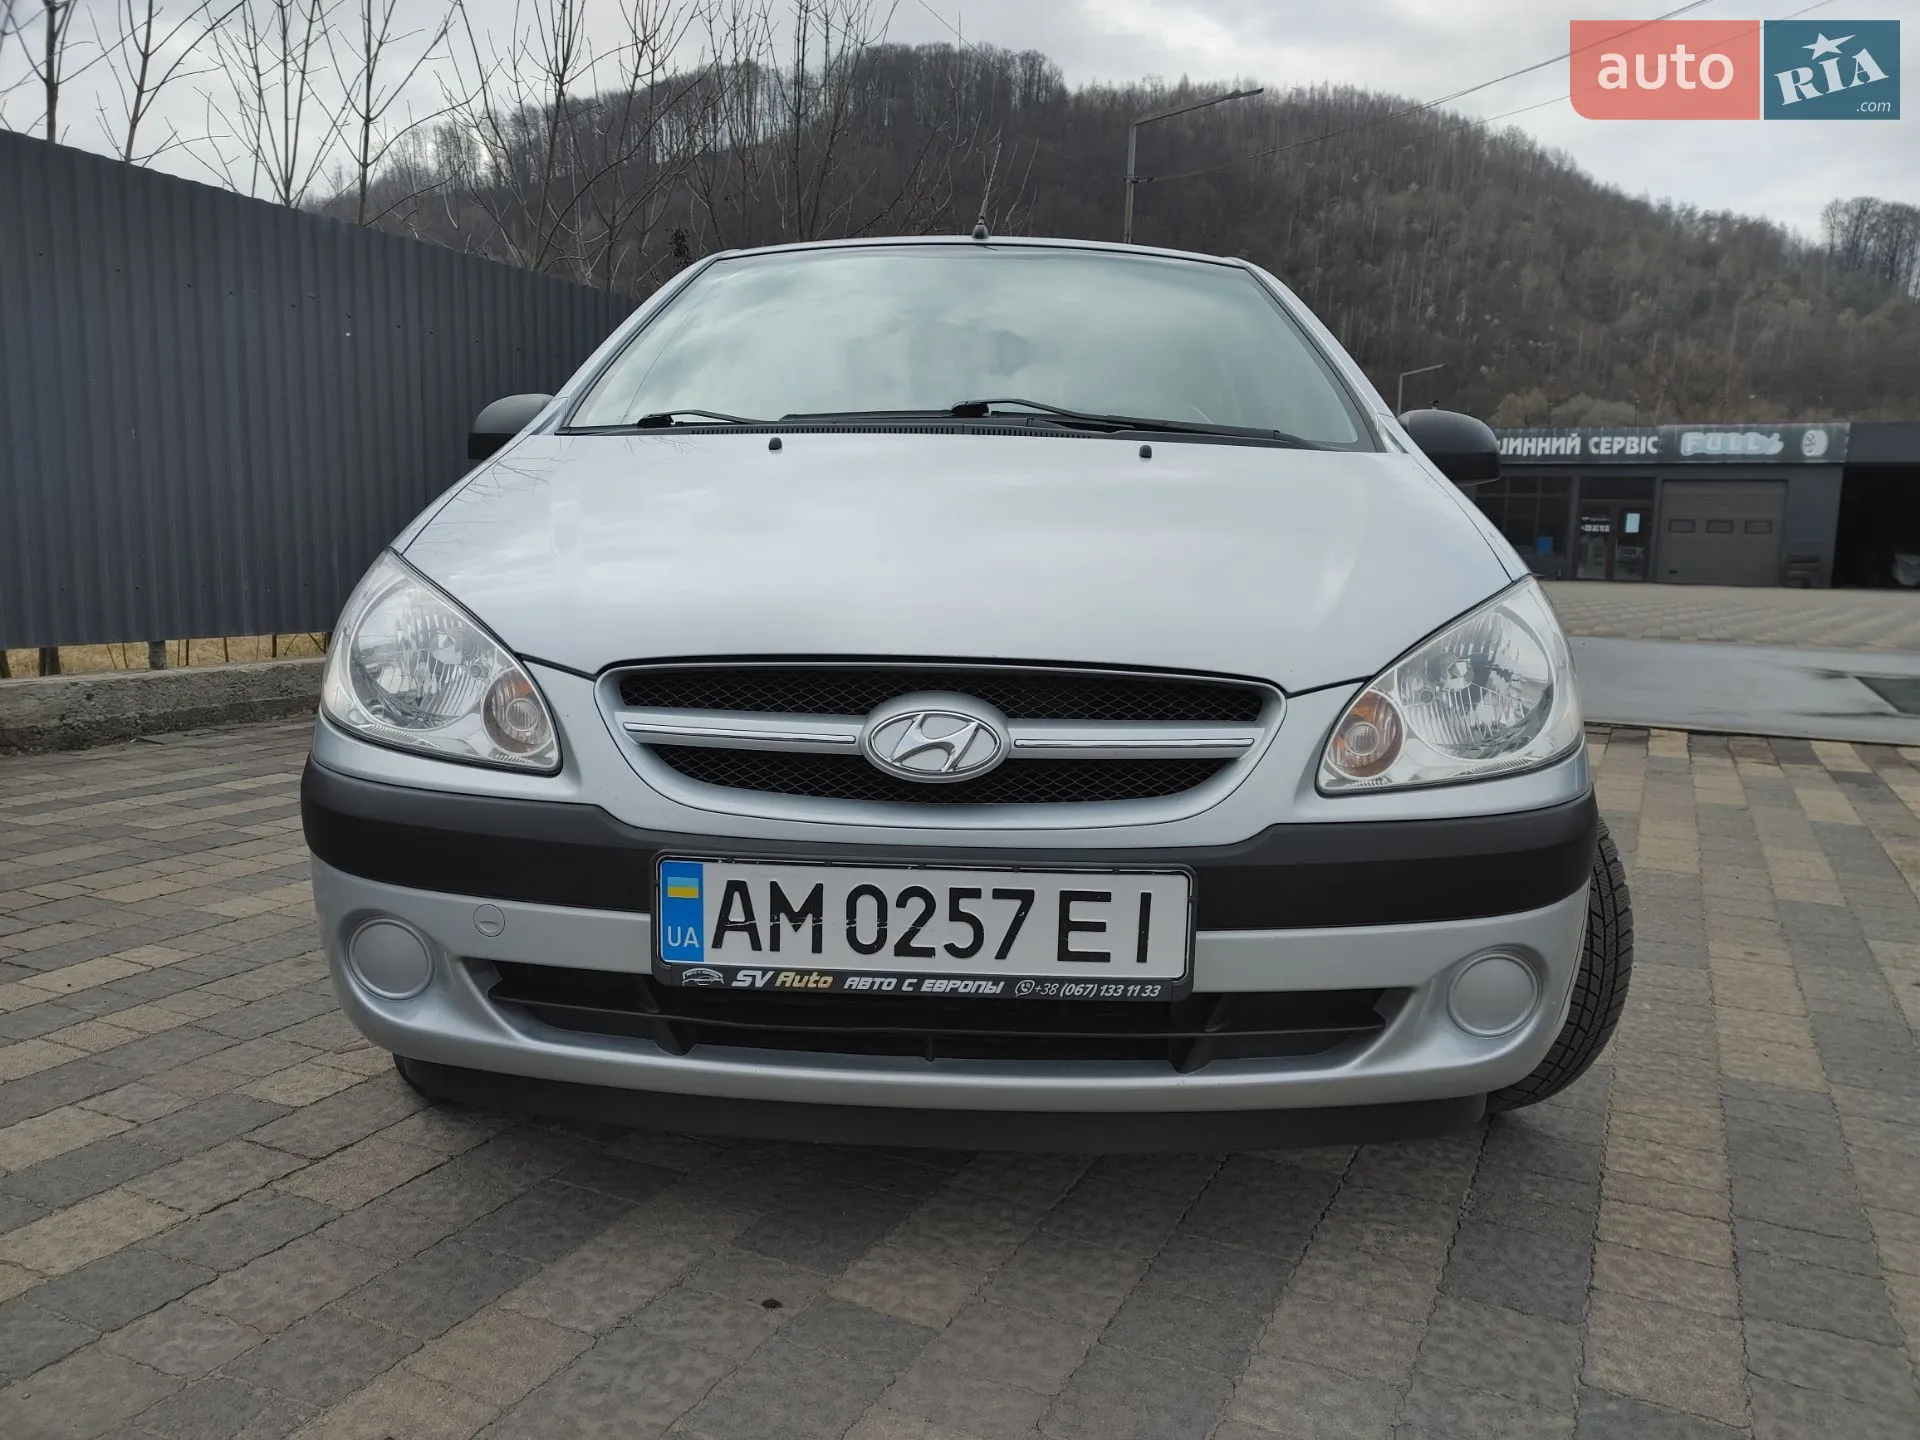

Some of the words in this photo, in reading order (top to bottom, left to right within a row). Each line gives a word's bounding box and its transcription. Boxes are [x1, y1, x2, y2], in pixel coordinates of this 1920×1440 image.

[1588, 436, 1659, 455] СЕРВІС
[711, 879, 824, 954] AM
[845, 883, 1036, 959] 0257
[1057, 889, 1152, 963] EI
[667, 925, 700, 948] UA
[731, 969, 775, 988] SV
[774, 971, 834, 989] Auto
[843, 976, 898, 991] АВТО
[920, 979, 1005, 994] ЕВРОПЫ
[1034, 982, 1059, 995] +38
[1059, 982, 1098, 998] (067)
[1099, 984, 1125, 997] 133
[1126, 985, 1141, 997] 11
[1141, 984, 1162, 997] 33
